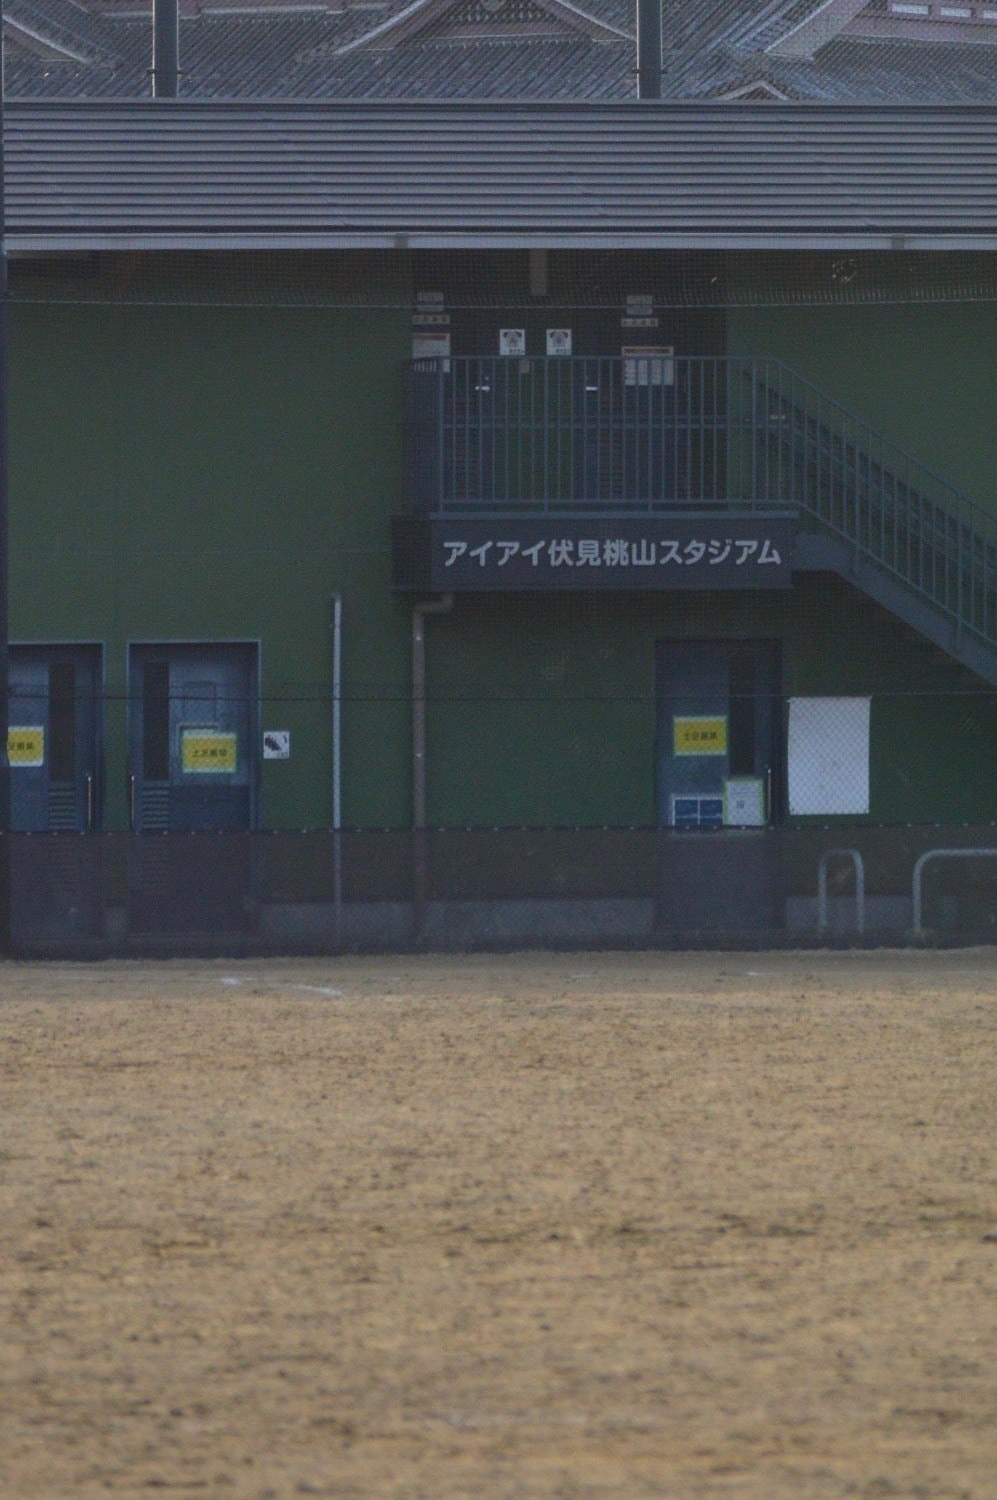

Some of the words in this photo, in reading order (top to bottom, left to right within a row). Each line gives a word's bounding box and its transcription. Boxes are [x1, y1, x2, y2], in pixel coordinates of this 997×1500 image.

[443, 538, 782, 567] アイアイ伏見桃山スタジアム
